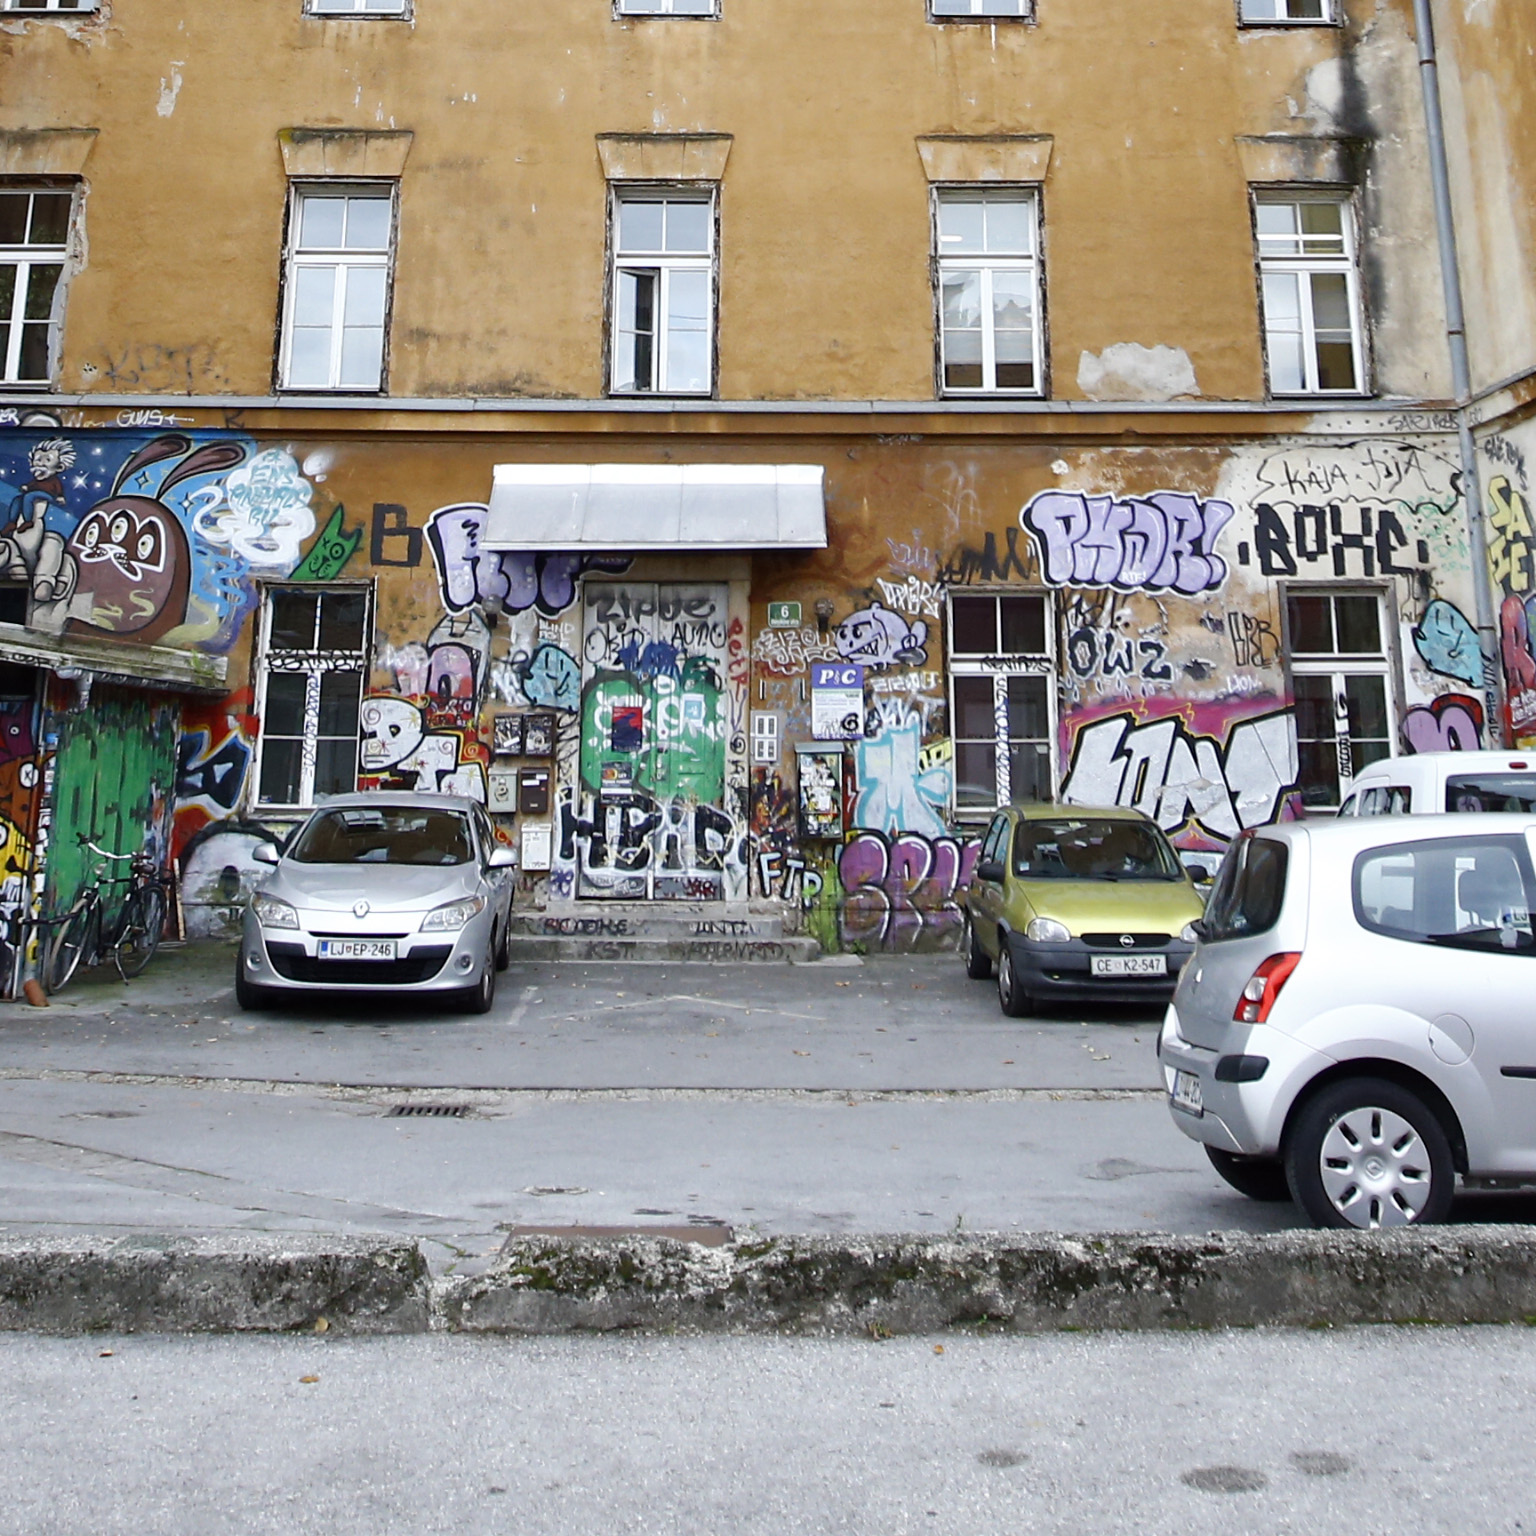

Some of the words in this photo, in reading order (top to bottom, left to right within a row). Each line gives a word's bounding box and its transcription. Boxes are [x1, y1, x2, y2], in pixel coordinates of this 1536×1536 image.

[781, 605, 790, 619] 6
[330, 943, 344, 956] LJ
[1097, 958, 1112, 972] CE
[1124, 958, 1161, 972] K2-547
